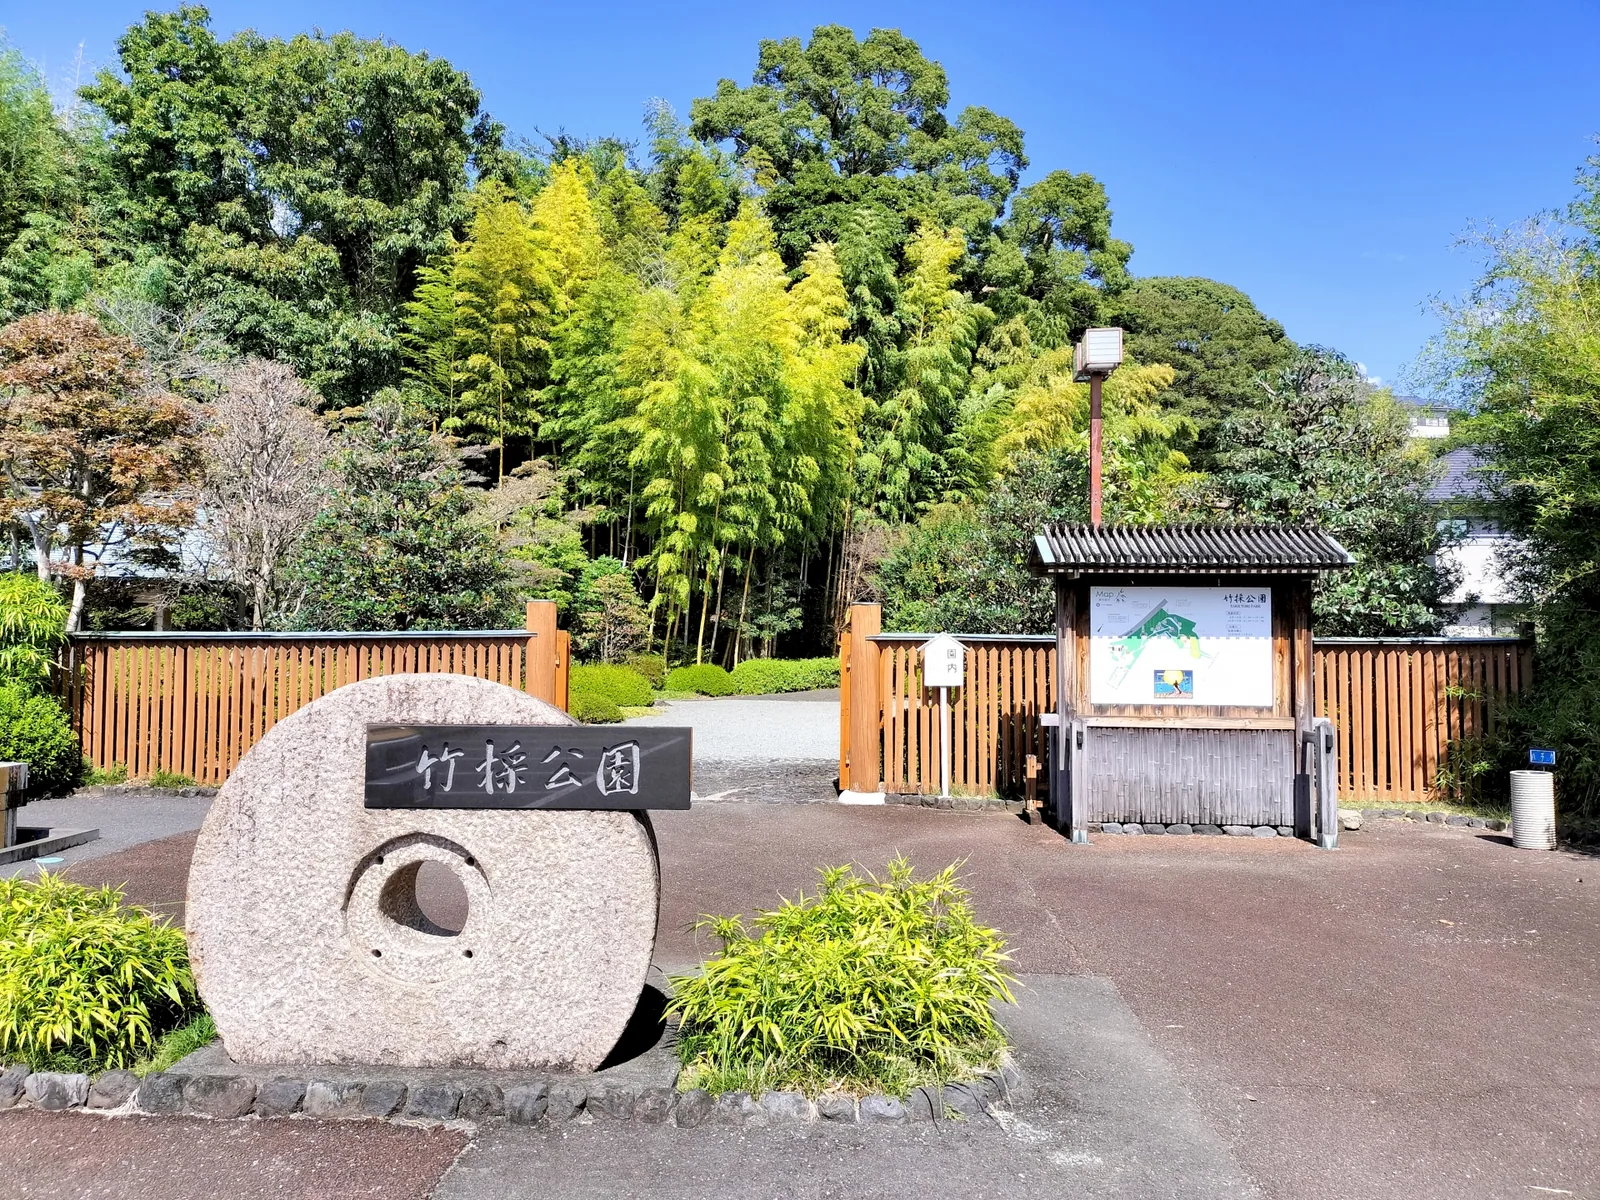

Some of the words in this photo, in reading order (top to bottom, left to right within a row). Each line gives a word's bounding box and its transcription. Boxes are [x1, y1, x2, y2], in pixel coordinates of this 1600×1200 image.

[1095, 590, 1114, 599] Map
[1223, 593, 1266, 603] 竹採公園
[416, 739, 640, 796] 竹採公園
